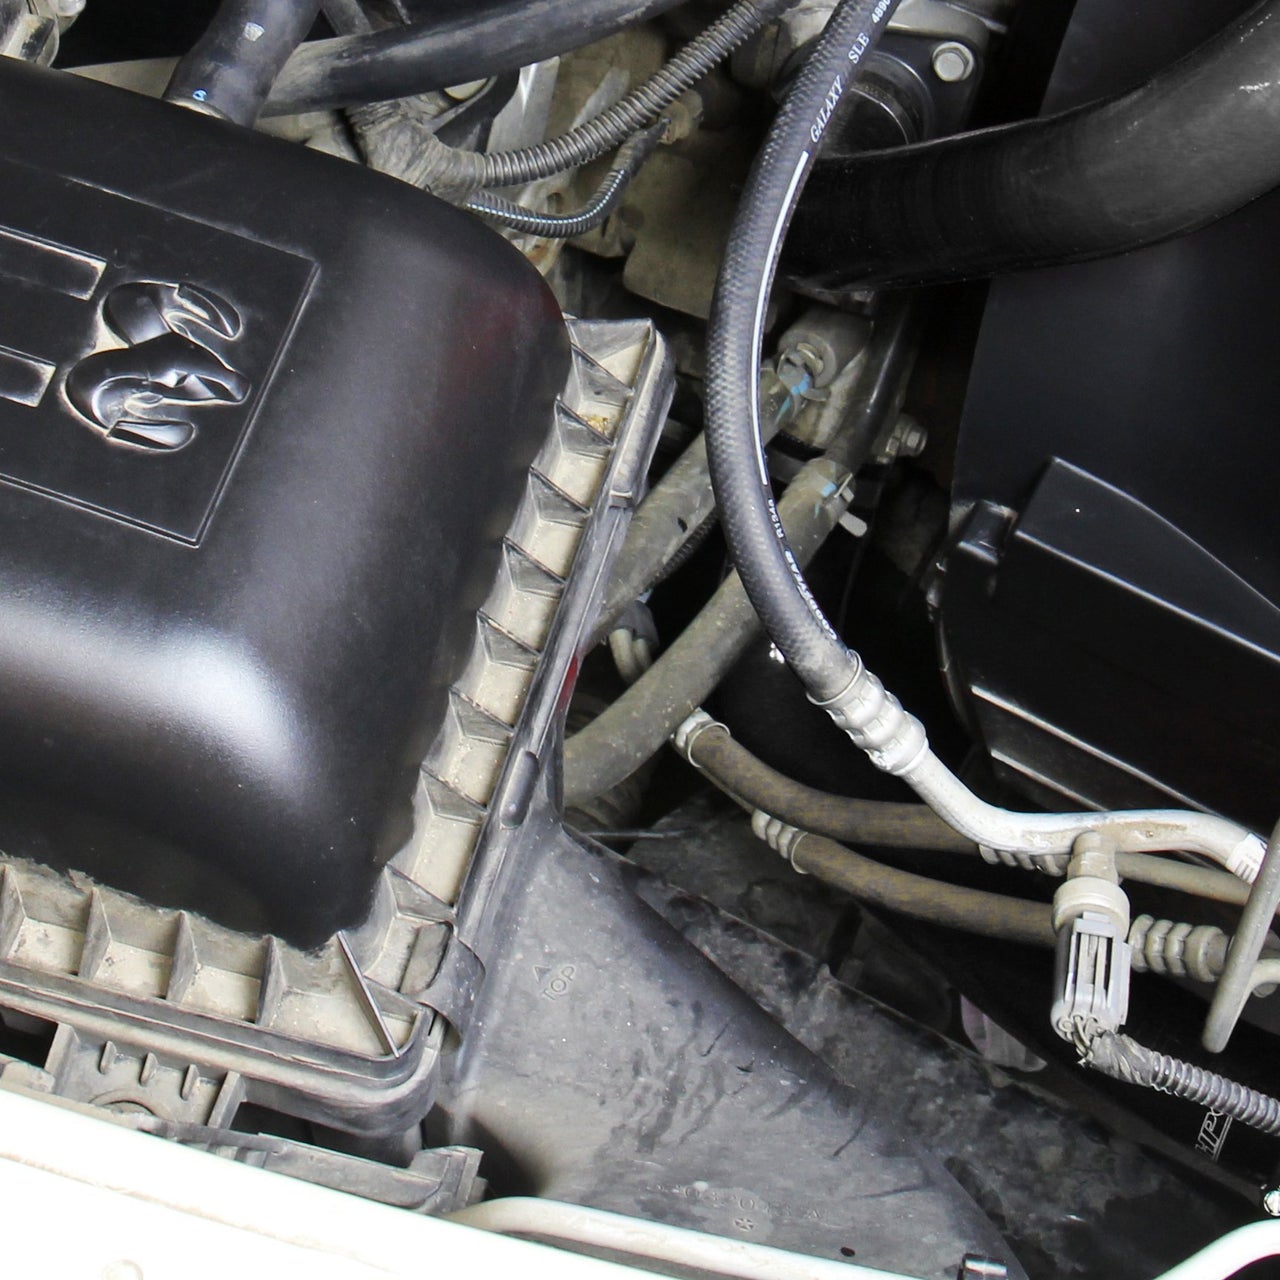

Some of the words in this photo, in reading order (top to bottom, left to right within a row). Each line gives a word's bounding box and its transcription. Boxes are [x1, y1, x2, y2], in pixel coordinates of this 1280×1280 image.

[810, 75, 845, 143] GALAXY
[848, 32, 870, 64] SLE
[542, 965, 575, 1001] TOP
